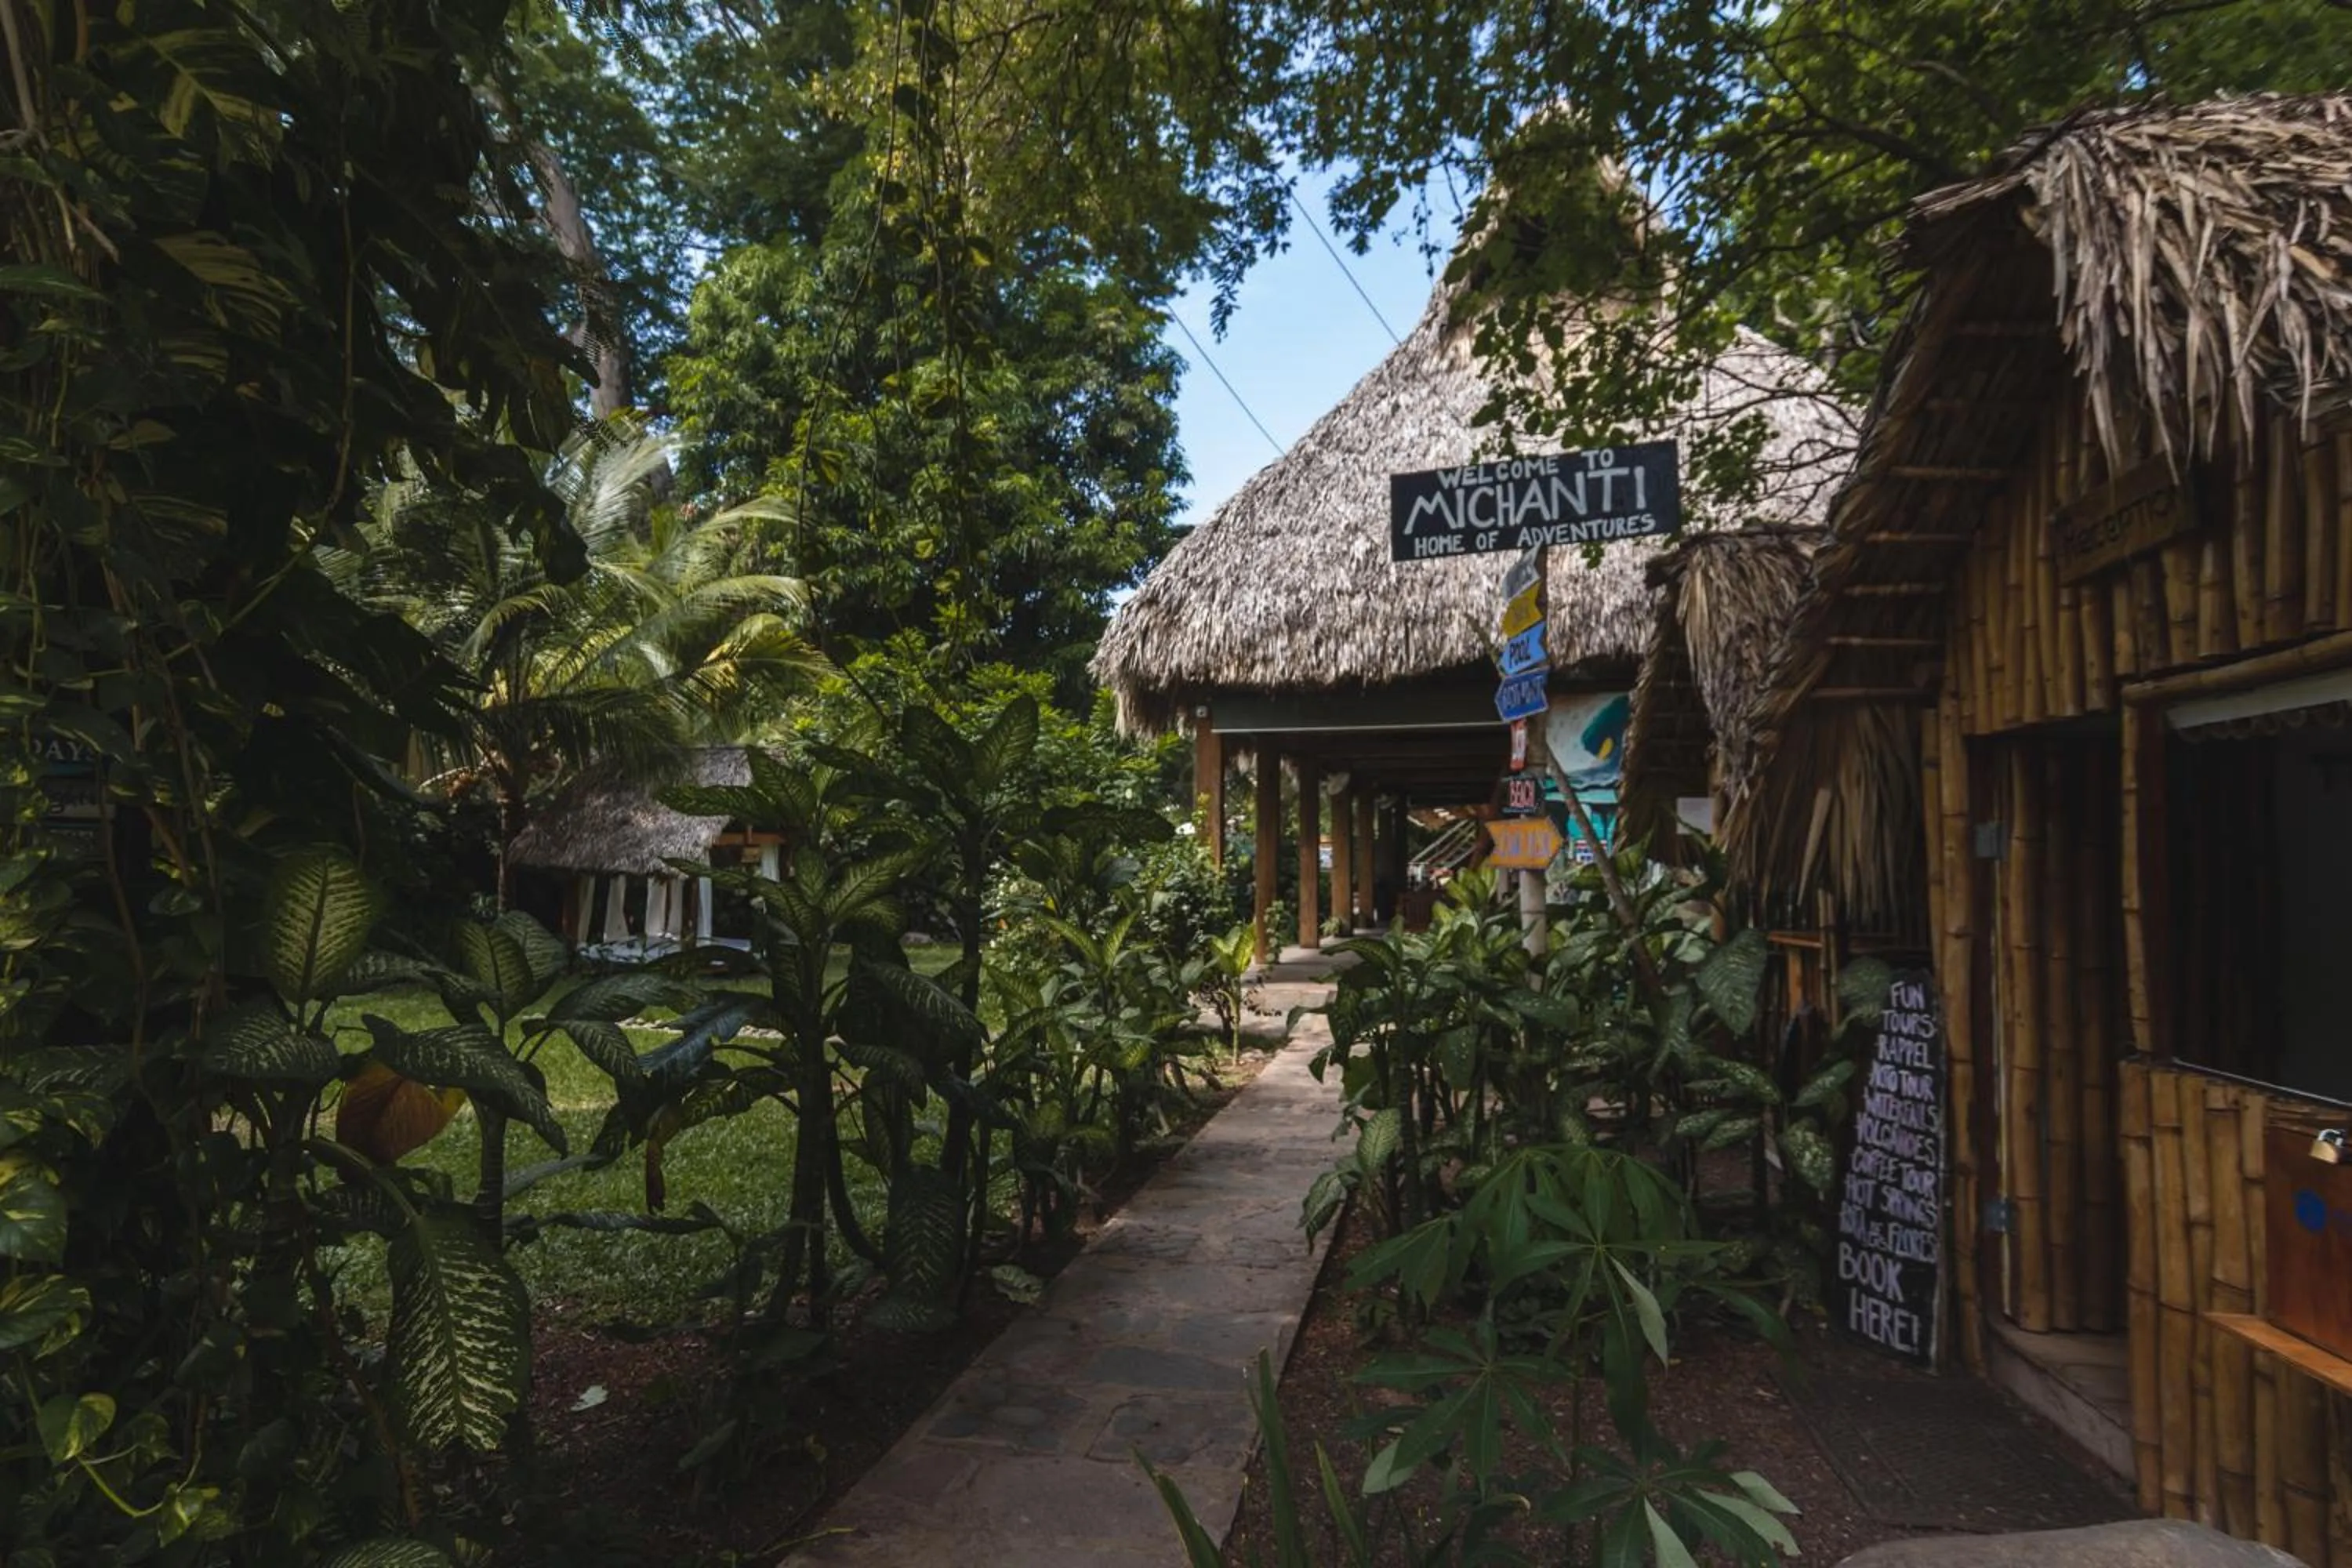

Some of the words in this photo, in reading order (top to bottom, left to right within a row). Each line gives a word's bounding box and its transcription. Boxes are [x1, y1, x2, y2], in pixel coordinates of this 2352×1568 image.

[1437, 456, 1559, 489] WELCOME
[1581, 448, 1615, 470] TO
[1403, 466, 1646, 535] MICHANTI
[1414, 533, 1466, 558] HOME
[1475, 530, 1500, 550] OF
[1516, 514, 1657, 548] ADVENTURES
[1508, 780, 1537, 808] BEACH
[1890, 981, 1926, 1009] FUN
[1875, 1033, 1935, 1070] RAPPEL
[1898, 1069, 1934, 1102] TOUR
[1855, 1111, 1937, 1167] VOLCANOES
[1845, 1173, 1878, 1209] HOT
[1850, 1145, 1899, 1182] COFFEE
[1899, 1163, 1936, 1203] TOUR
[1838, 1241, 1904, 1303] BOOK
[1849, 1287, 1920, 1356] HERE!
